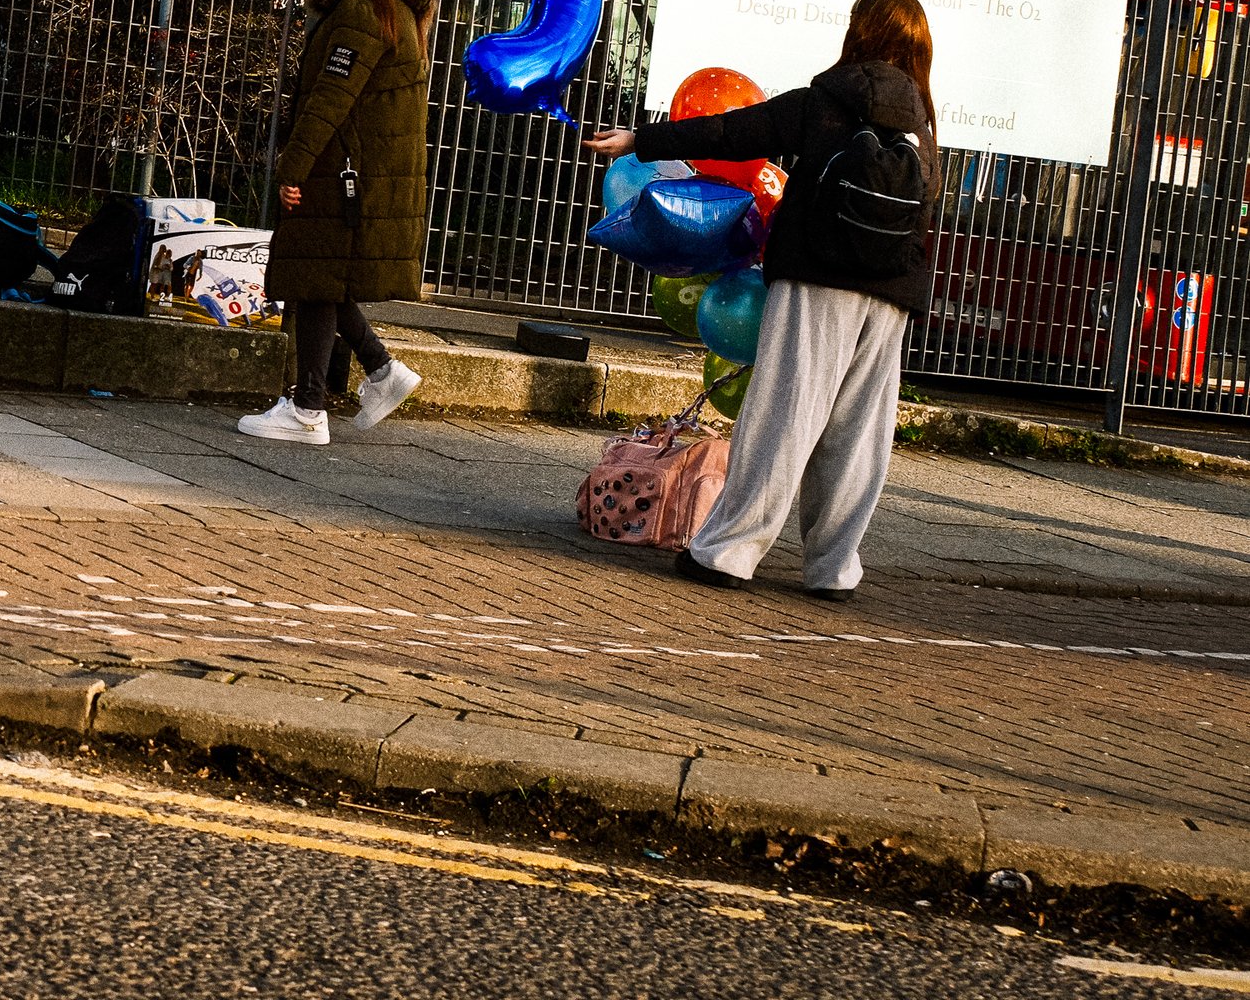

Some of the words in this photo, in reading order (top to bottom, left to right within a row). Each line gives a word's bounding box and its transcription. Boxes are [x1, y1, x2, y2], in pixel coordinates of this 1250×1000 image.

[803, 2, 851, 27] Distr
[1019, 0, 1042, 21] O2
[951, 104, 977, 125] the
[981, 111, 1016, 130] road
[205, 245, 224, 260] Tic
[224, 247, 250, 262] Tac
[250, 249, 270, 265] Tos
